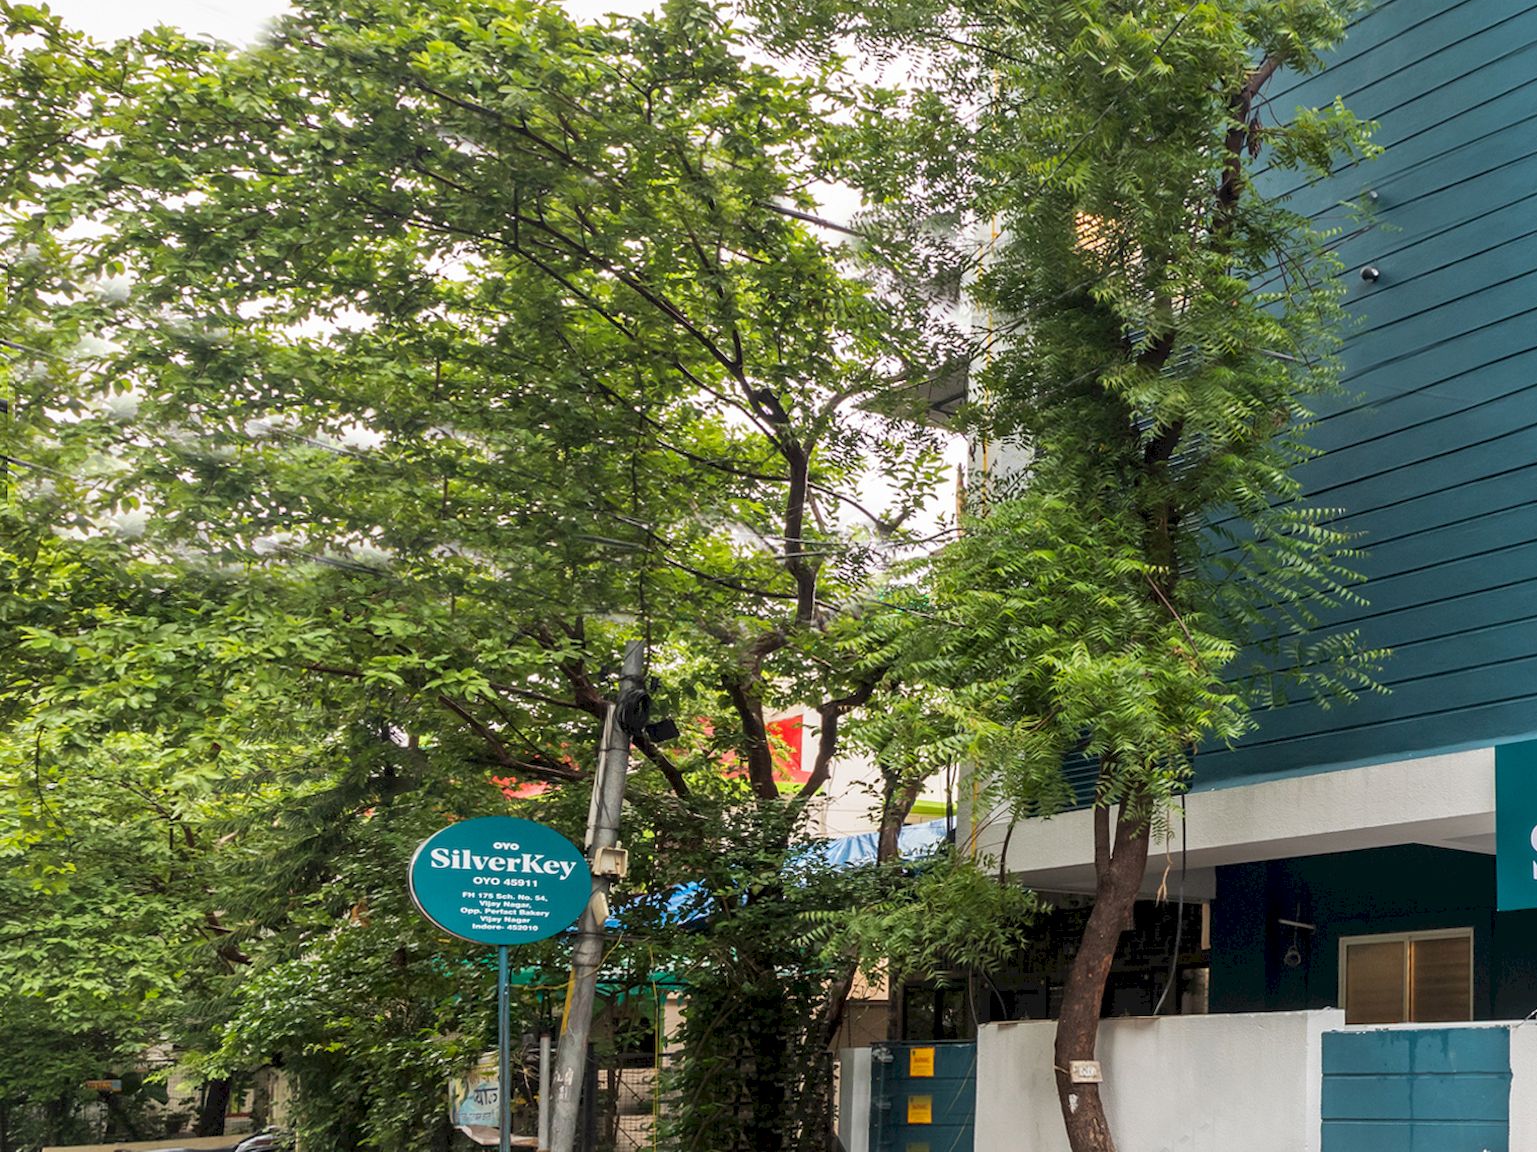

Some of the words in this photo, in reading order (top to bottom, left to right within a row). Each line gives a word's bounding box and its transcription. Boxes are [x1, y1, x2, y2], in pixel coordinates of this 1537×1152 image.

[493, 841, 520, 851] OYO
[430, 847, 577, 880] SilverKey
[472, 876, 501, 886] OYO
[503, 878, 538, 888] 45911
[479, 900, 501, 908] Vijay
[460, 907, 482, 915] Opp.
[518, 909, 550, 918] Bakery
